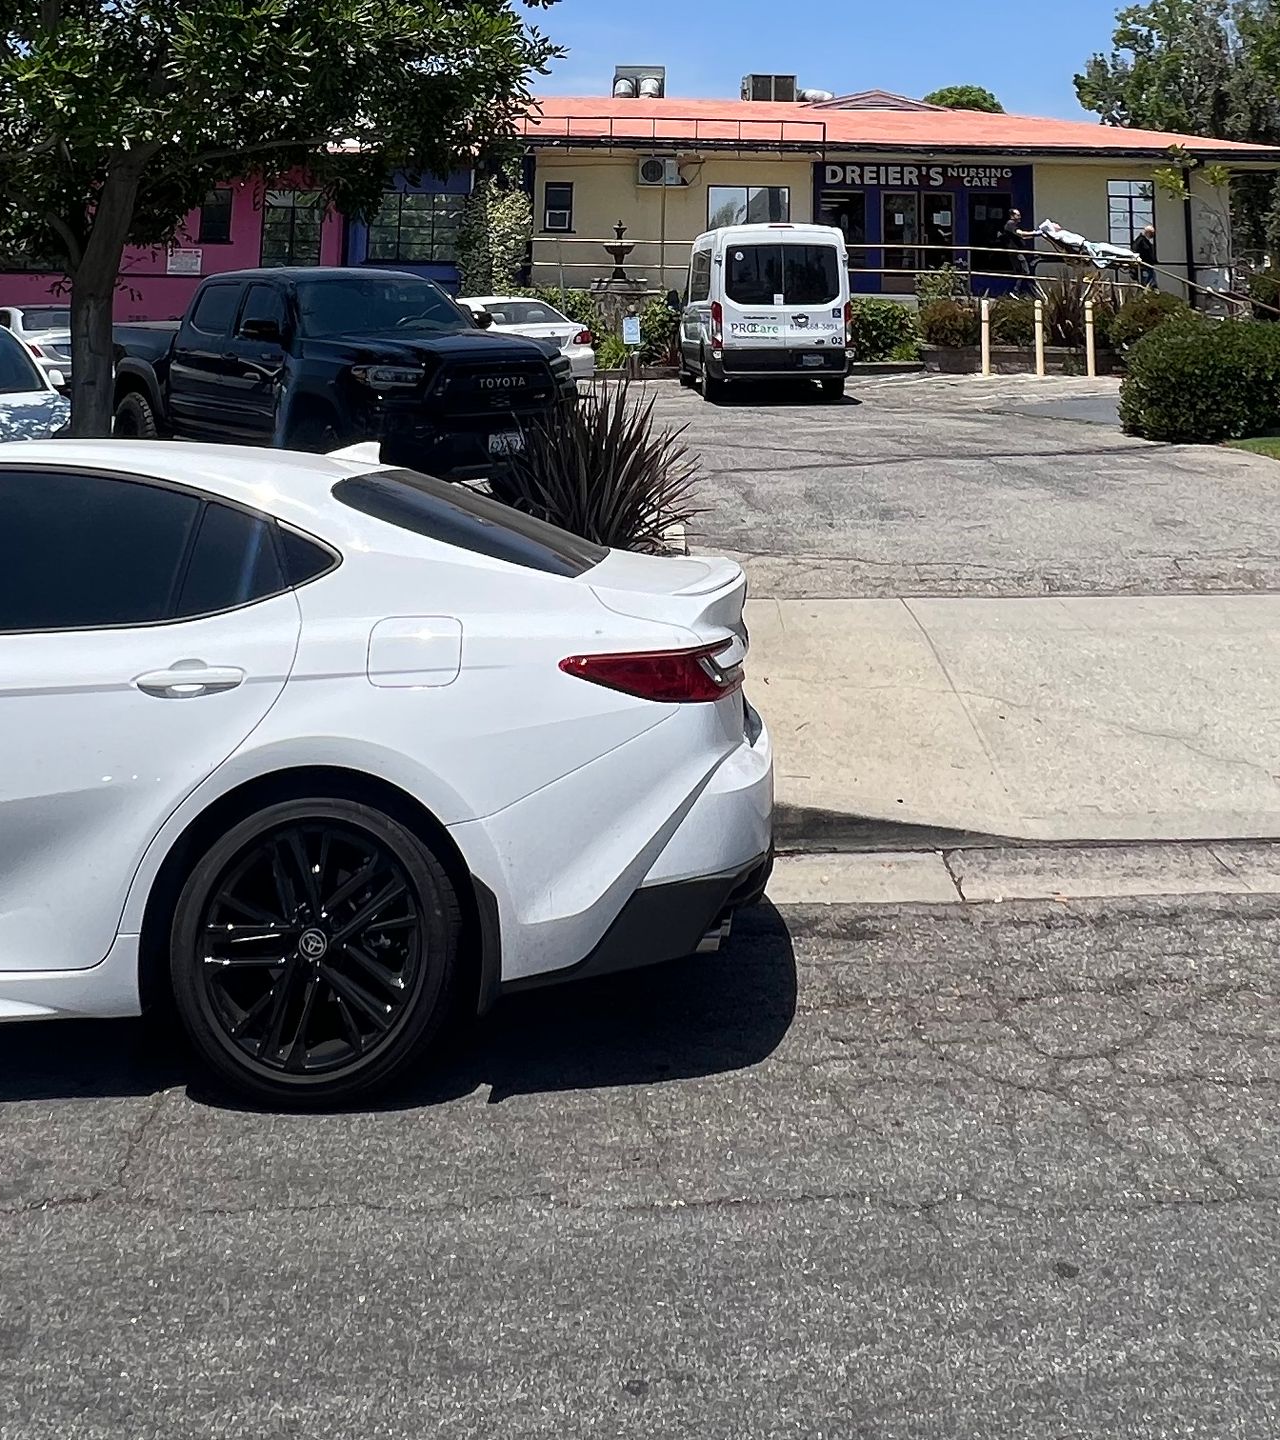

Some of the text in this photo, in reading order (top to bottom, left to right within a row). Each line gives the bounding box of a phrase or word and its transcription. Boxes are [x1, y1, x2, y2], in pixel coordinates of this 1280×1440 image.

[825, 165, 944, 186] DREIER'S
[947, 168, 1012, 178] NURSING
[963, 177, 998, 187] CARE
[831, 336, 843, 345] 02
[480, 376, 526, 388] TOYOTA
